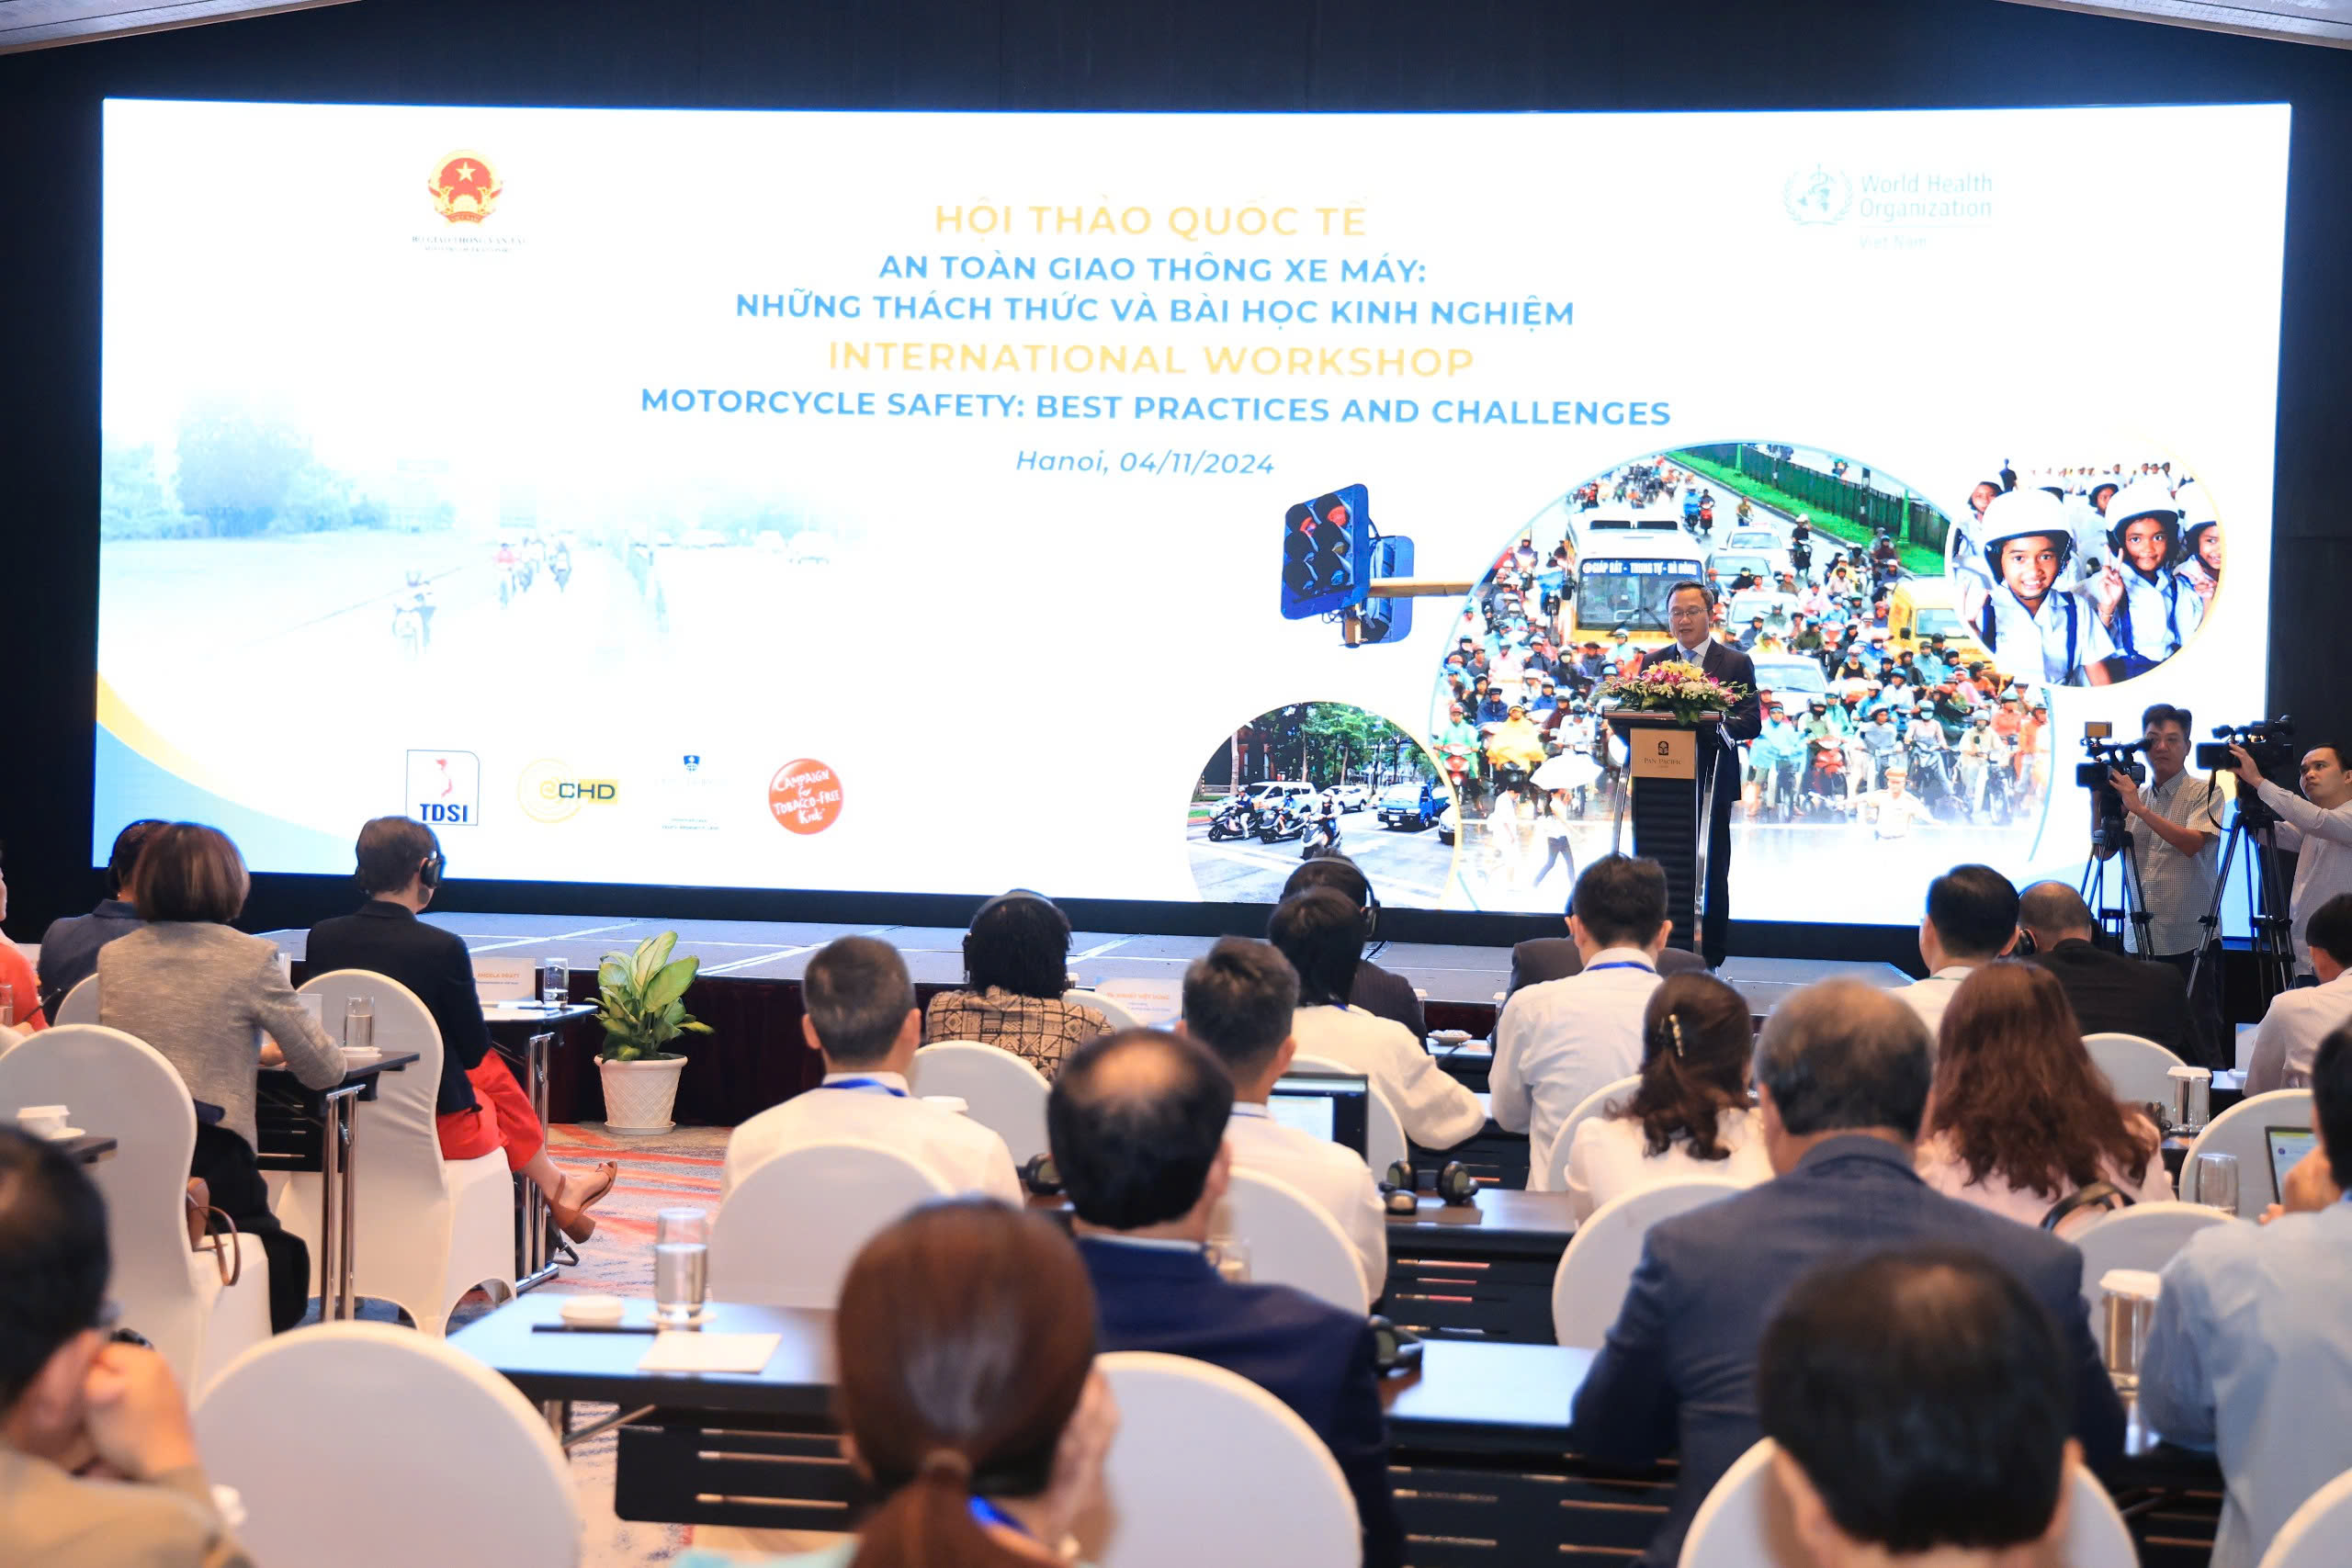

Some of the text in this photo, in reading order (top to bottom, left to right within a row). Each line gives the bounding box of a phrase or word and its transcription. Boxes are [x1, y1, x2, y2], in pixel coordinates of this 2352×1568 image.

[1860, 172, 1993, 193] World Health
[935, 197, 1012, 243] HỘI
[1029, 195, 1152, 235] THẢO
[1860, 197, 1993, 222] Organization
[878, 250, 1426, 284] AN TOÀN GIAO THÔNG XE MÁY:
[737, 288, 1573, 333] NHỮNG THÁCH THỨC VÀ BÀI HỌC KINH NGHIỆM
[831, 341, 1474, 378] INTERNATIONAL WORKSHOP
[642, 388, 1671, 426] MOTORCYCLE SAFETY: BEST PRACTICES AND CHALLENGES
[1016, 449, 1274, 476] Hanoi, 04/11/2024
[559, 783, 616, 800] CHD
[774, 770, 830, 792] CAMPAIGN
[419, 803, 468, 822] TDSI
